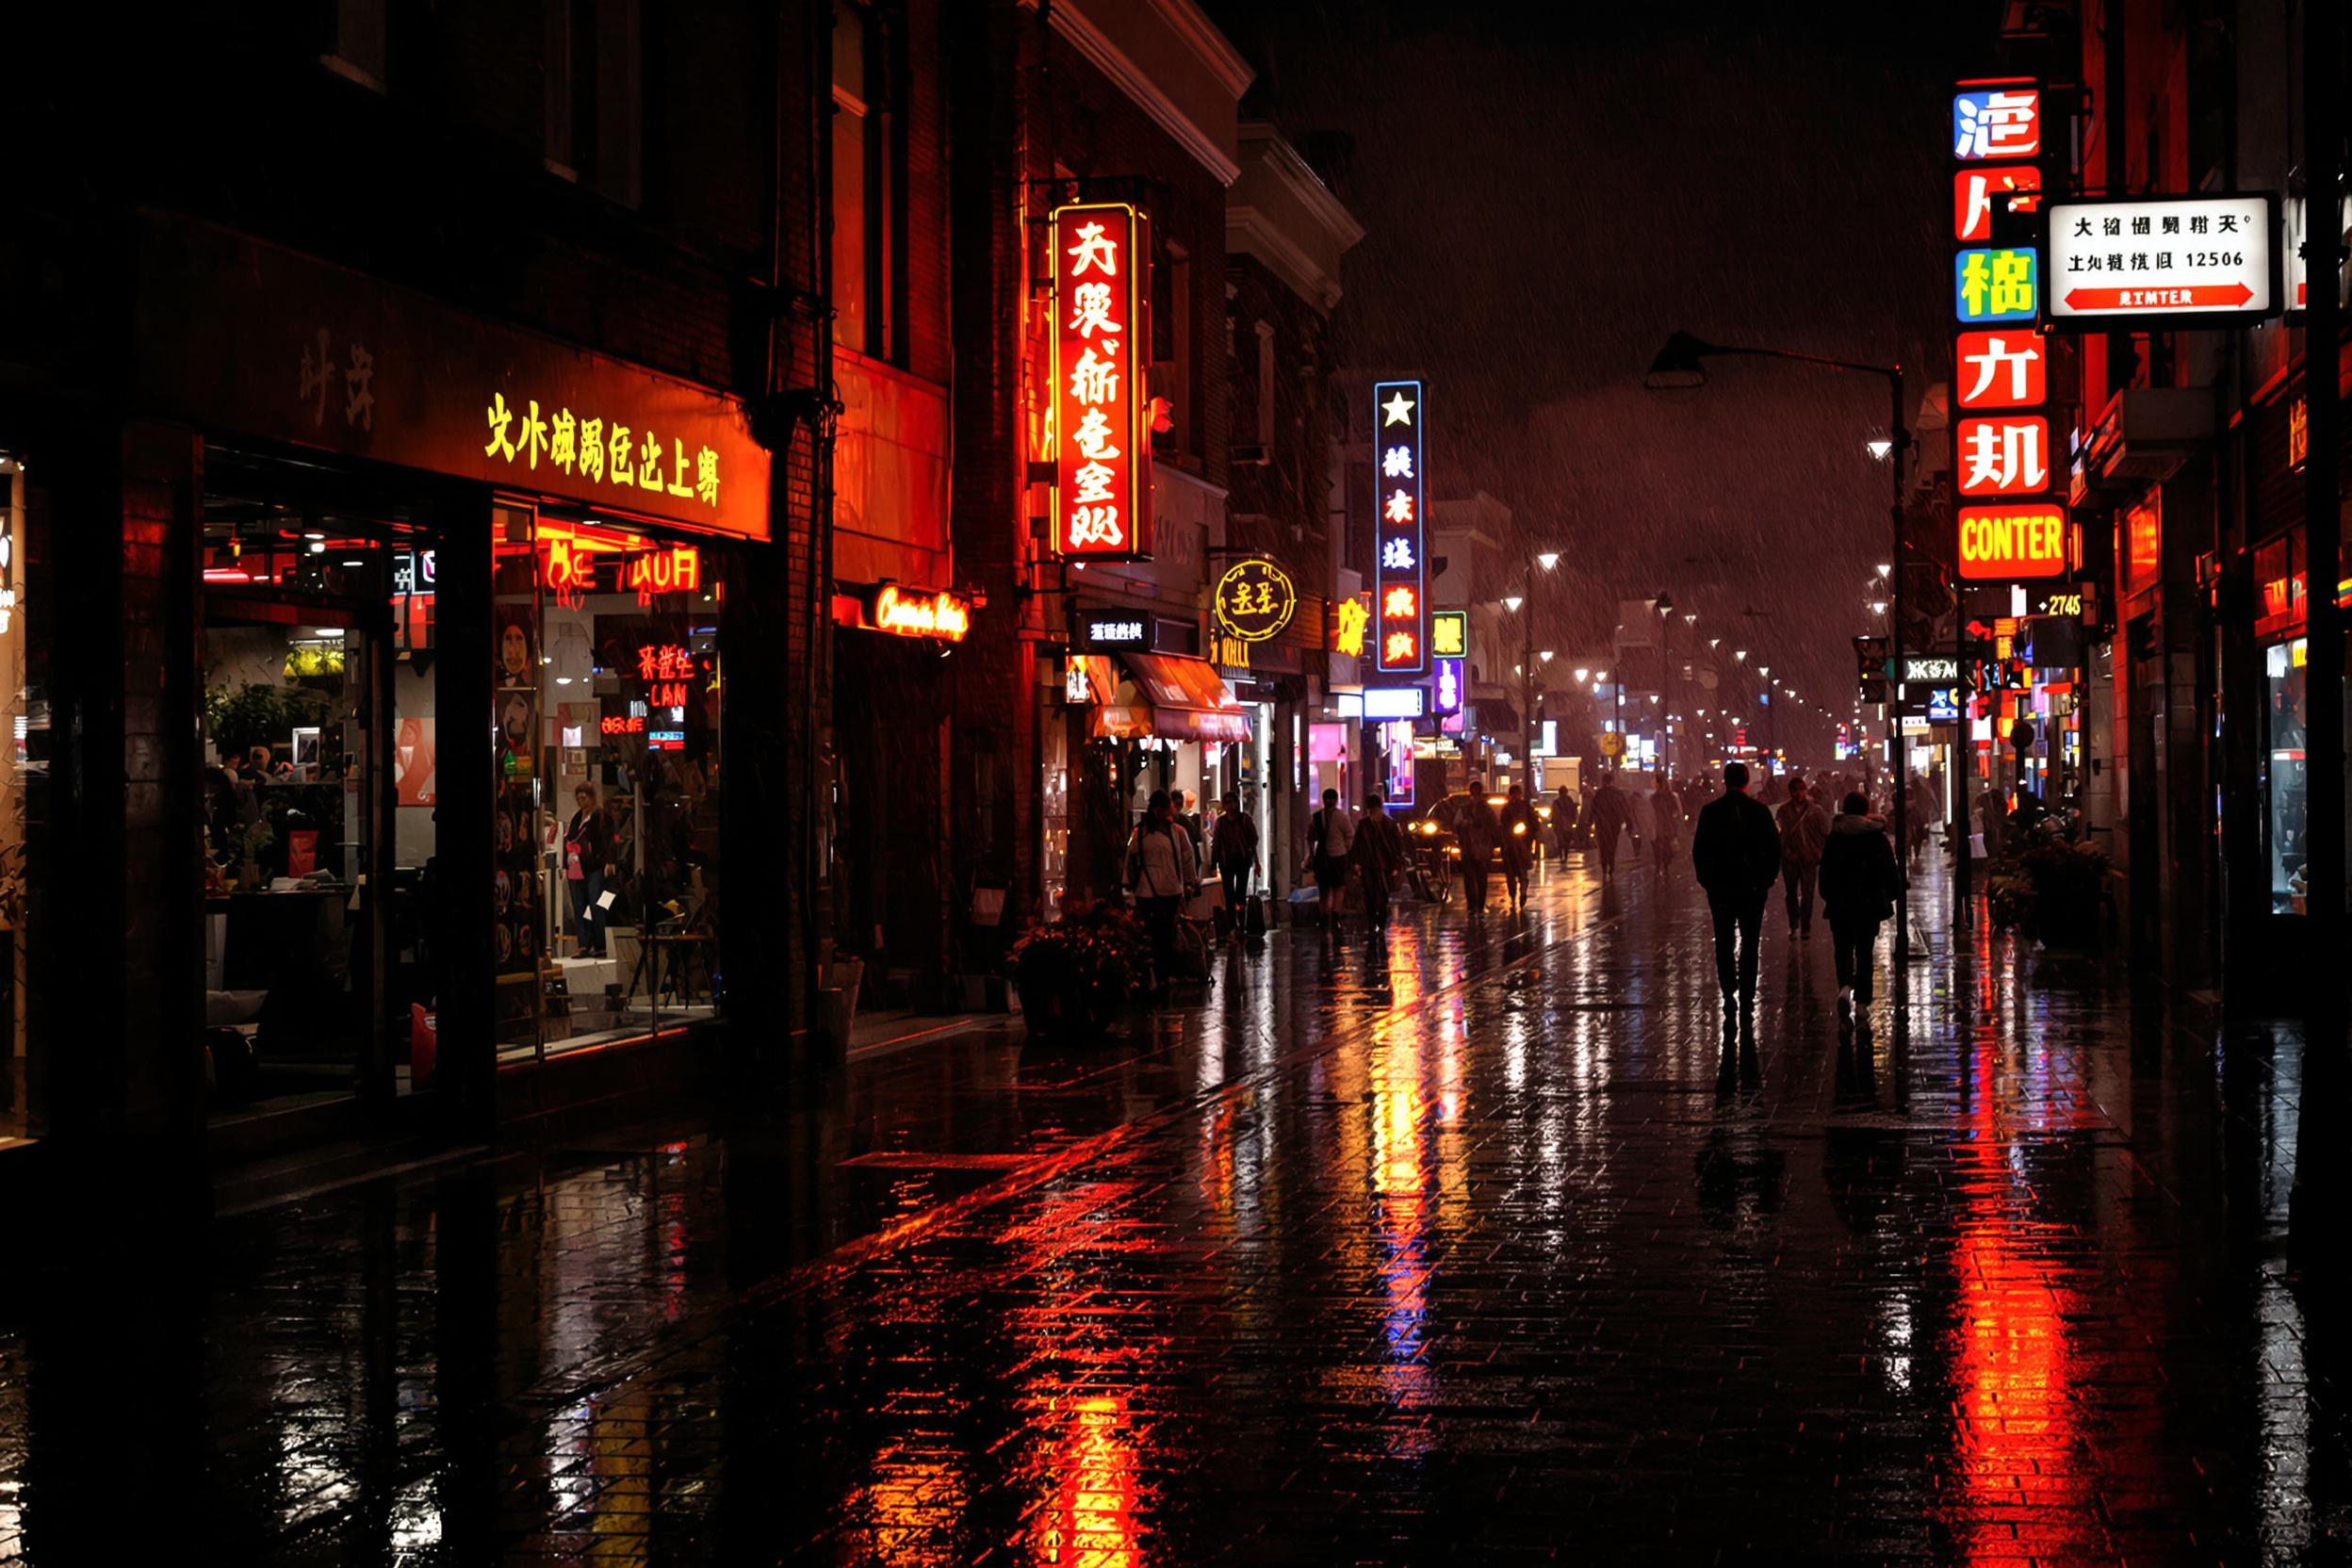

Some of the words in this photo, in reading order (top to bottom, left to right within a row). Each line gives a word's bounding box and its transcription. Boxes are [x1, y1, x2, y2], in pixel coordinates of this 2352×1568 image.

[2186, 252, 2243, 267] 12506
[1961, 516, 2062, 562] CONTER
[651, 682, 687, 707] LAN
